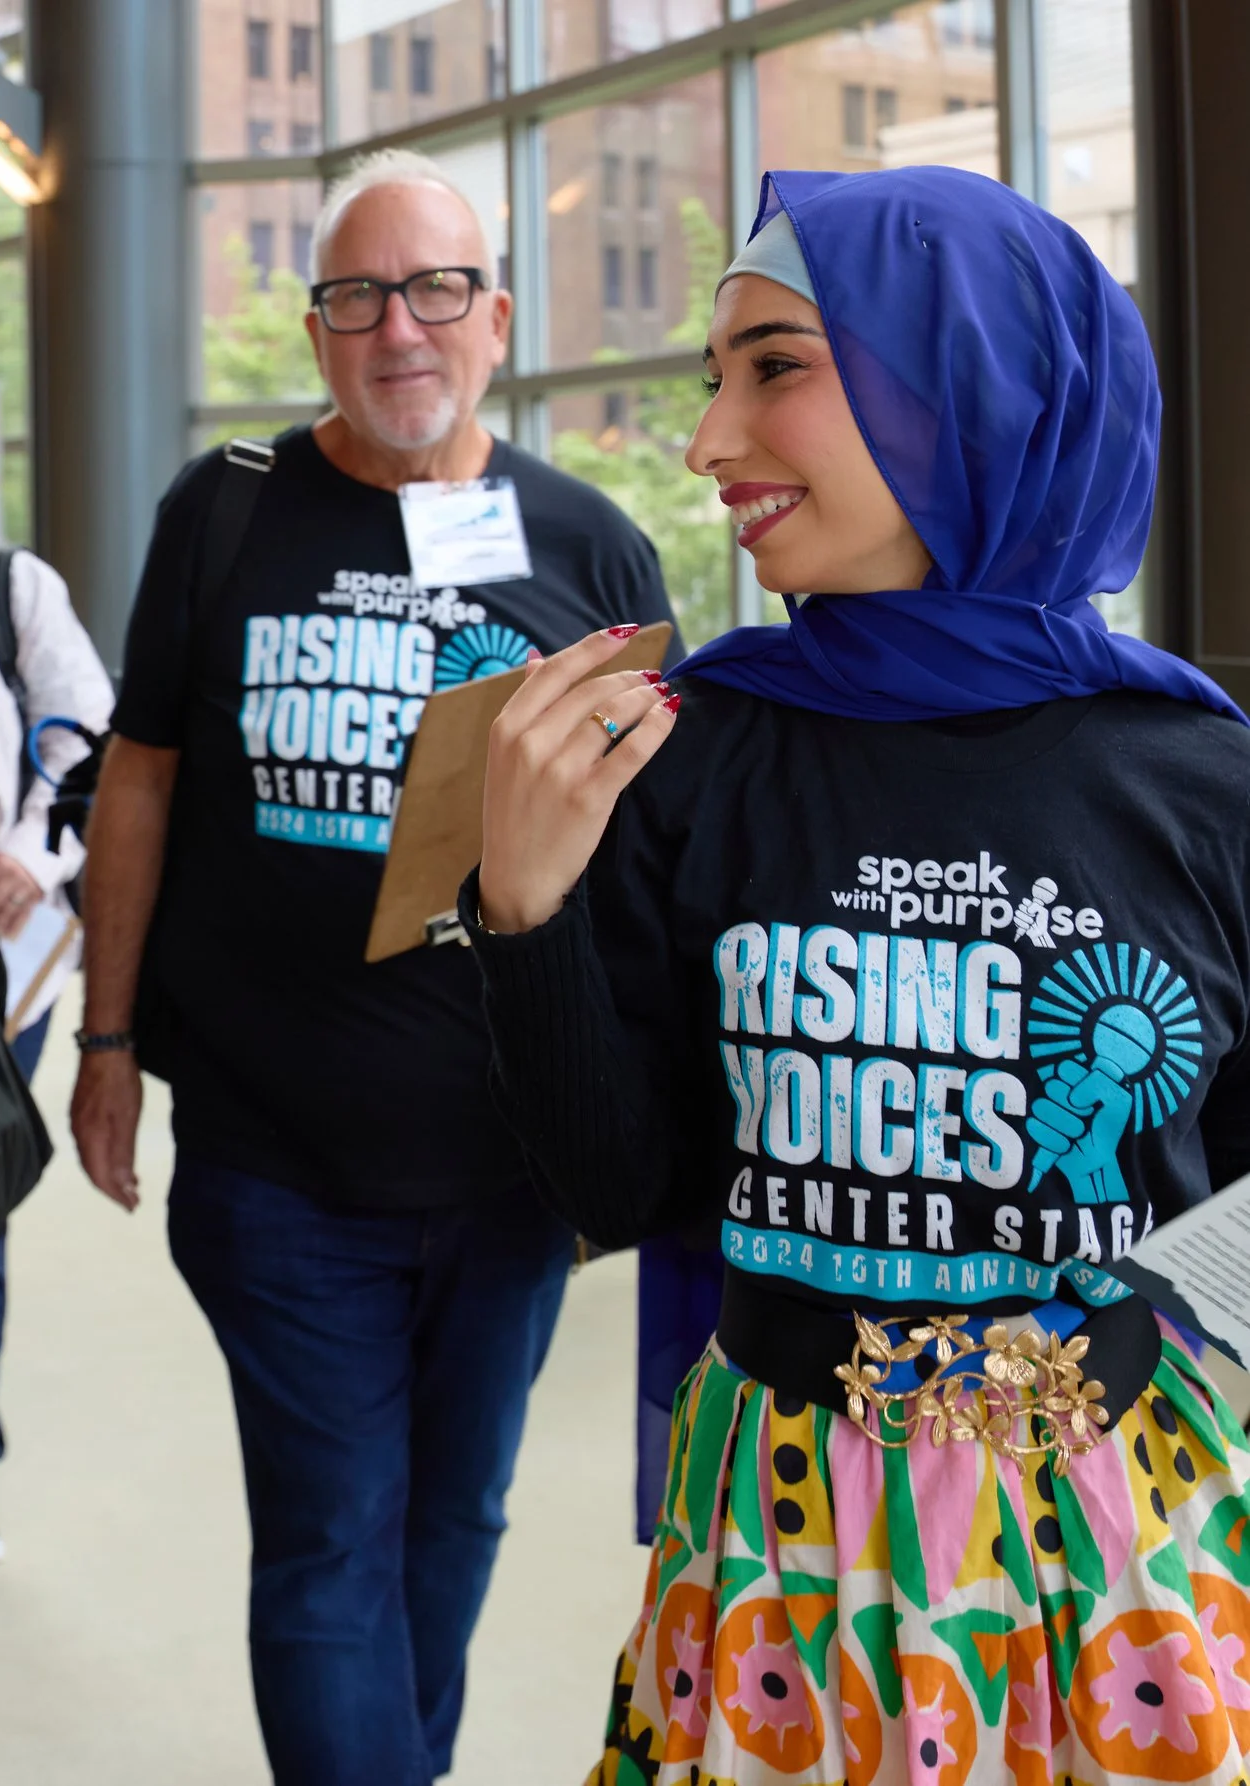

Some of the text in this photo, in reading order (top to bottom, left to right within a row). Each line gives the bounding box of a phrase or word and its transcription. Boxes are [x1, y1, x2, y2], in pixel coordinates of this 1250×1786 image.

[242, 614, 435, 696] RISING
[252, 765, 393, 815] CENTER
[831, 888, 886, 913] with
[857, 850, 1010, 895] speak
[713, 922, 1022, 1061] RISING
[720, 1040, 1027, 1191] VOICES
[728, 1166, 955, 1251] CENTER
[729, 1230, 814, 1273] 2024
[832, 1253, 912, 1290] 10TH
